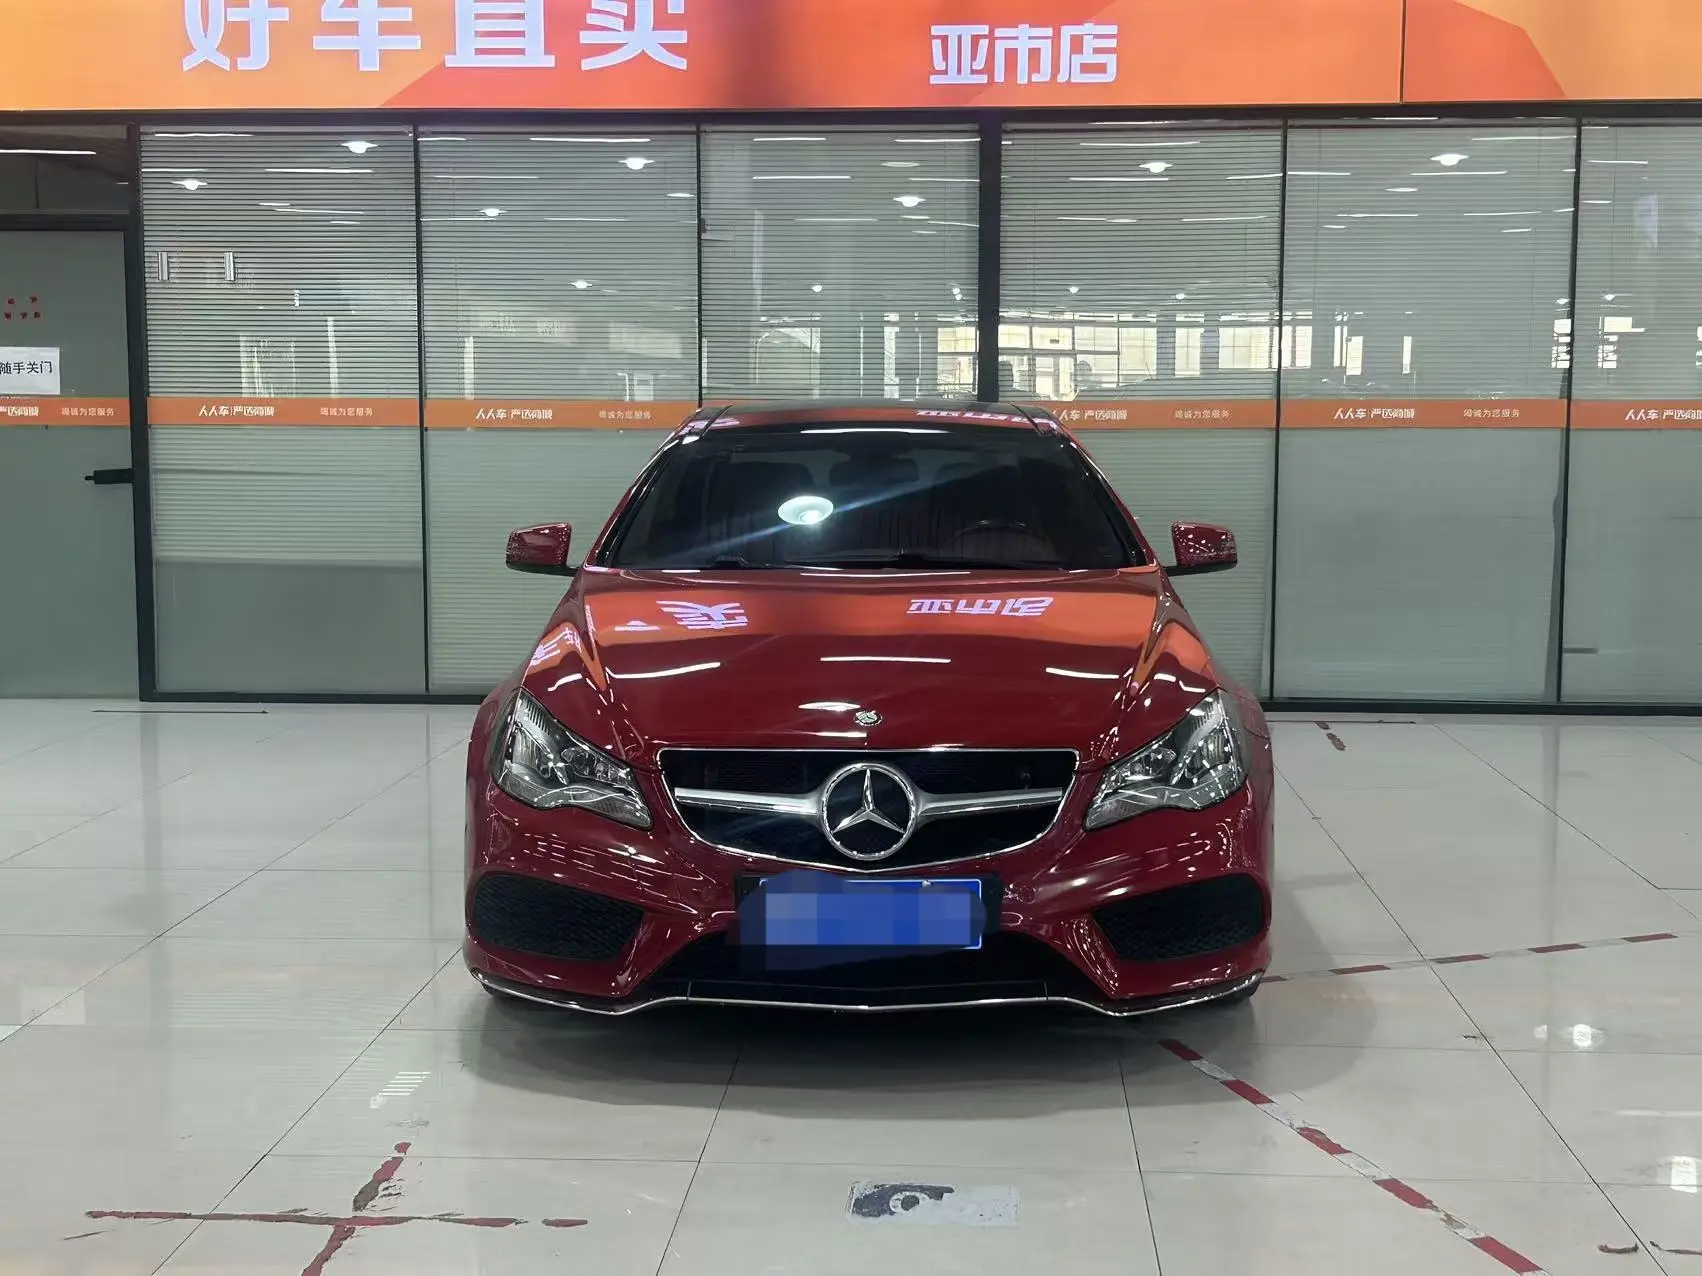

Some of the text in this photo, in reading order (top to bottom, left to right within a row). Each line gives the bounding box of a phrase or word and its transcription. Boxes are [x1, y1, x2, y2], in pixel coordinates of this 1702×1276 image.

[183, 0, 688, 71] 好车直卖
[930, 23, 1117, 85] 亚市店
[0, 361, 53, 375] 随手关门
[199, 405, 229, 417] 人人车
[475, 408, 507, 420] 人人车
[1334, 408, 1367, 419] 人人车
[1625, 409, 1659, 420] 人人车
